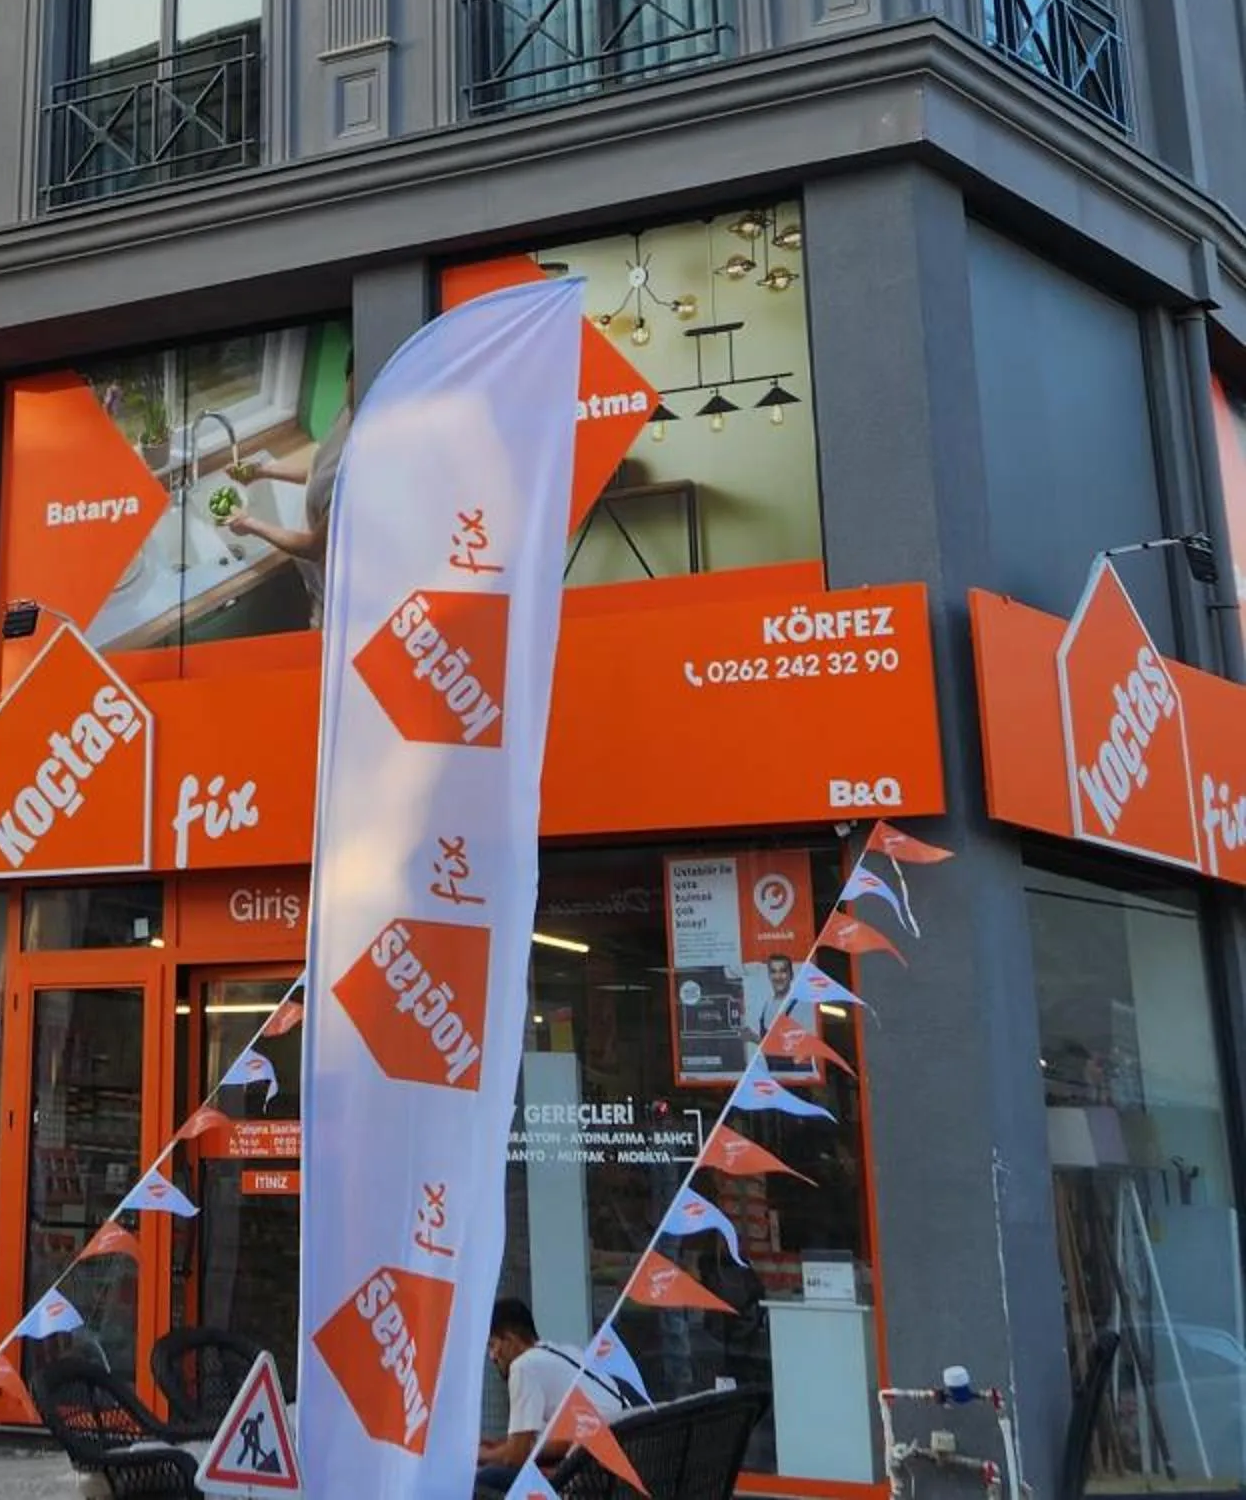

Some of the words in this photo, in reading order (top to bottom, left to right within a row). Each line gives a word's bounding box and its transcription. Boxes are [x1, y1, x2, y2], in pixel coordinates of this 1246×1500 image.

[46, 495, 140, 526] Batarya
[449, 508, 506, 575] fix
[762, 605, 895, 645] KÖRFEZ
[390, 593, 502, 744] koçtaş
[707, 657, 770, 684] 0262
[775, 653, 821, 679] 242
[826, 651, 858, 676] 32
[864, 647, 900, 672] 90
[1078, 645, 1176, 835] koçtaş
[828, 776, 903, 808] B&Q
[172, 773, 259, 870] fix
[430, 835, 486, 905] fix
[229, 887, 301, 929] Giriş
[370, 922, 481, 1085] koçtaş
[524, 1096, 635, 1130] GEREÇLERİ
[570, 1131, 646, 1145] AYDINLATMA
[654, 1131, 694, 1148] BAHÇE
[617, 1146, 672, 1164] MOBİLYA
[413, 1182, 456, 1258] fix
